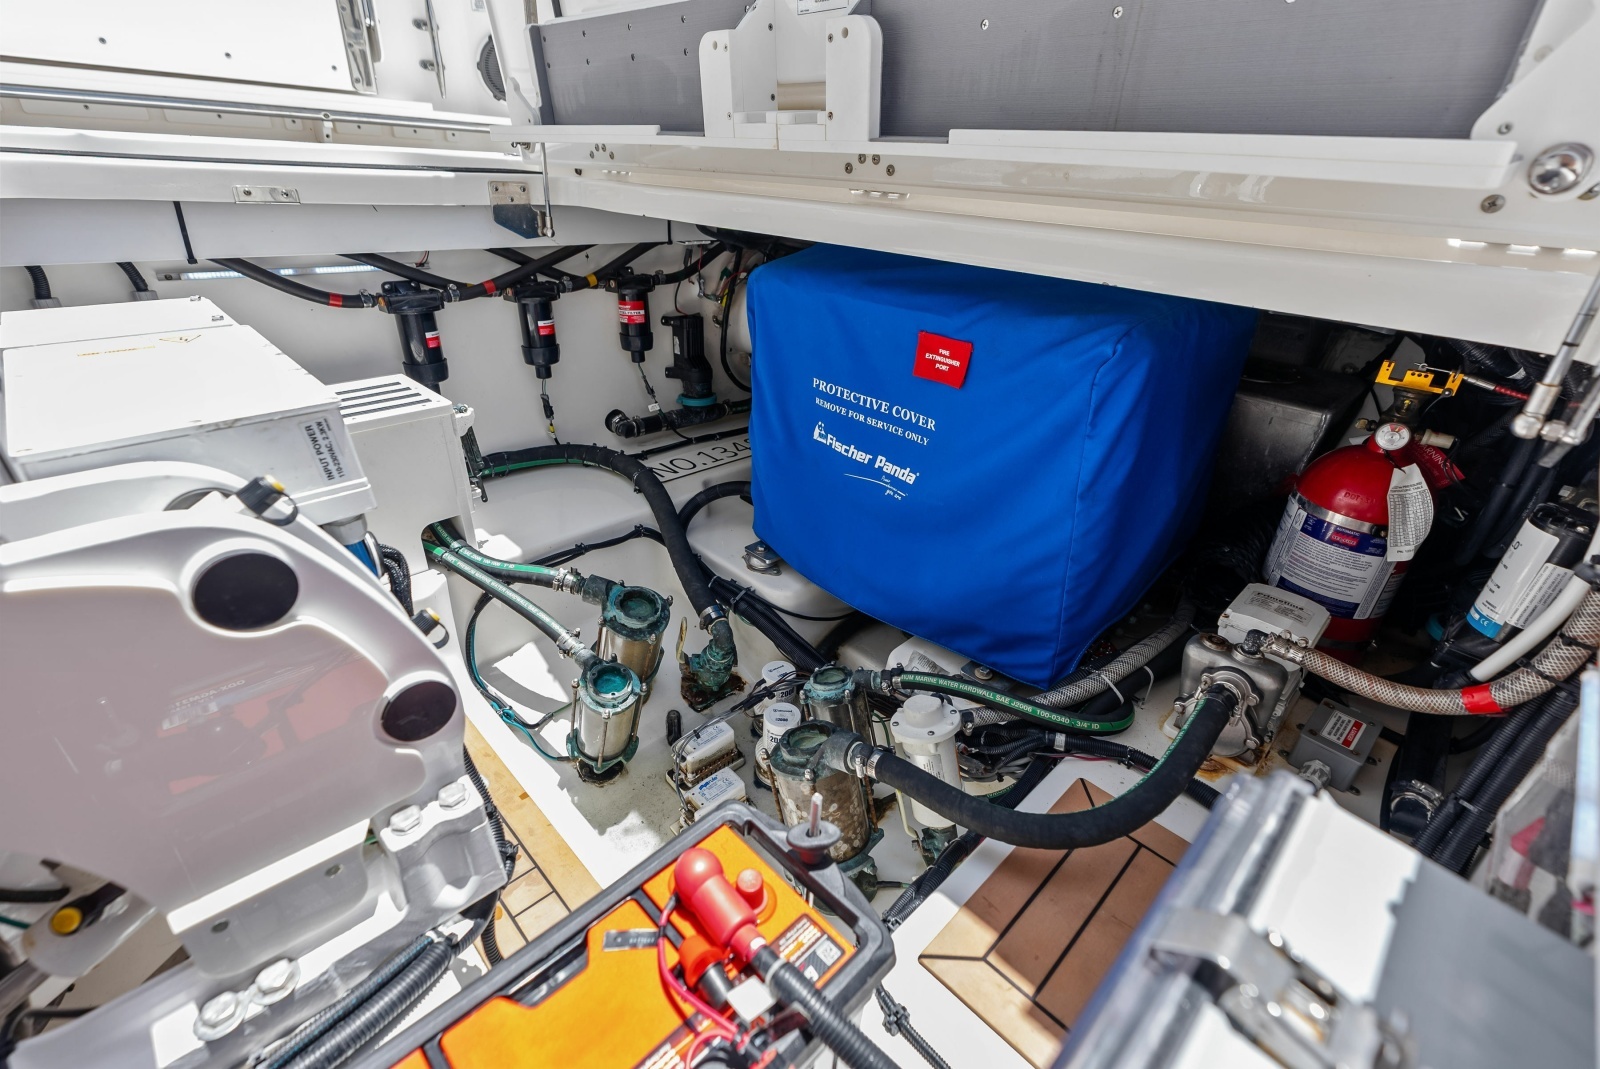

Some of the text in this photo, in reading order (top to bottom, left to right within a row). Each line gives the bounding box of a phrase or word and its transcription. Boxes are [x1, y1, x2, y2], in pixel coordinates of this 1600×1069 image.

[925, 352, 961, 368] EXTINGUISHER
[935, 363, 950, 372] PORT
[938, 348, 950, 357] FIRE
[812, 377, 936, 432] PROTECTIVE COVER
[815, 397, 929, 446] REMOVE FOR SERVICE ONLY
[304, 424, 335, 481] INPUT POWER
[826, 433, 917, 485] Fischer Panda
[490, 579, 506, 593] WATER
[914, 675, 938, 685] MARINE
[938, 678, 959, 690] WATER
[959, 683, 995, 699] HARDWALL
[995, 694, 1011, 706] SAE
[1010, 698, 1033, 712] J2006
[1036, 709, 1070, 724] 100-0340
[1091, 723, 1100, 731] ID
